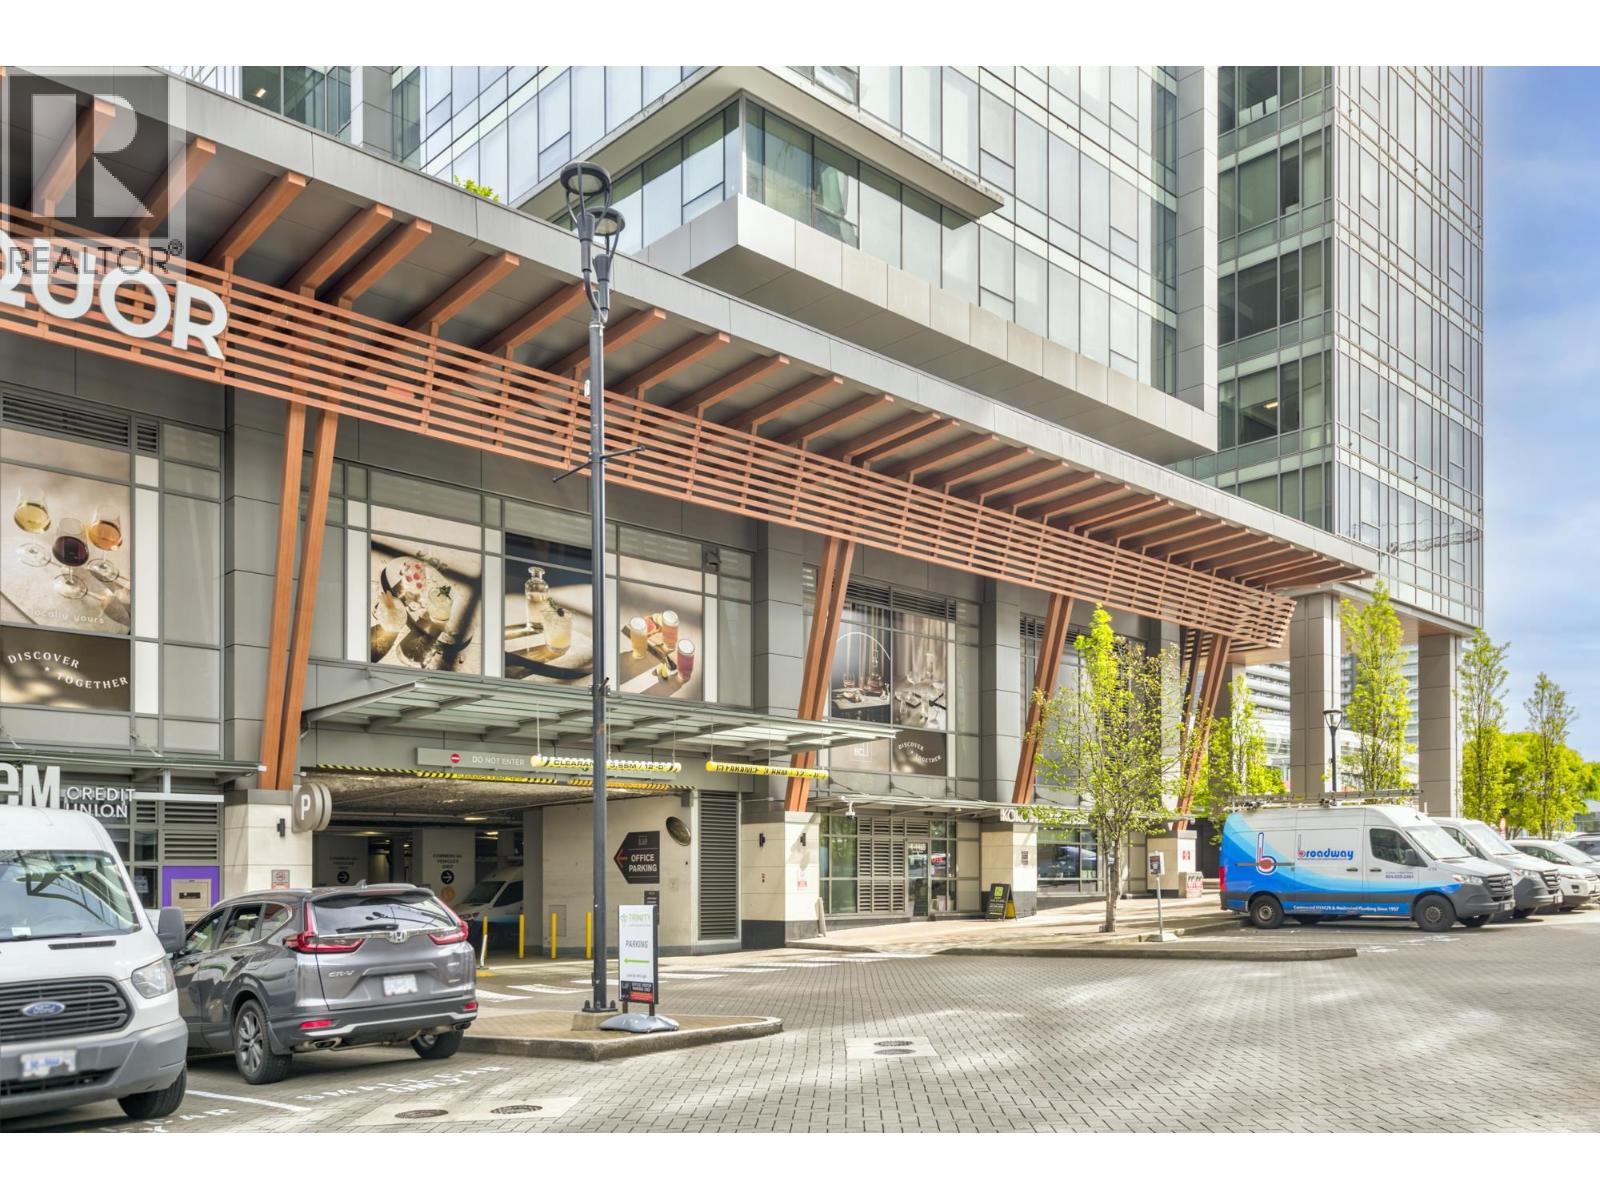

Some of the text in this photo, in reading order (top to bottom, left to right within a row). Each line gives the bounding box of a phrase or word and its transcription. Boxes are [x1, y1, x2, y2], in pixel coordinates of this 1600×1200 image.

[73, 614, 105, 624] yours
[8, 651, 79, 668] DISCOVER
[57, 671, 129, 689] TOGETHER
[472, 756, 525, 766] DO NOT ENTER
[66, 786, 136, 801] CREDIT
[300, 794, 311, 821] P
[631, 854, 655, 862] OFFICE
[628, 864, 658, 872] PARKING
[624, 939, 649, 949] PARKING
[30, 1003, 60, 1014] Ford
